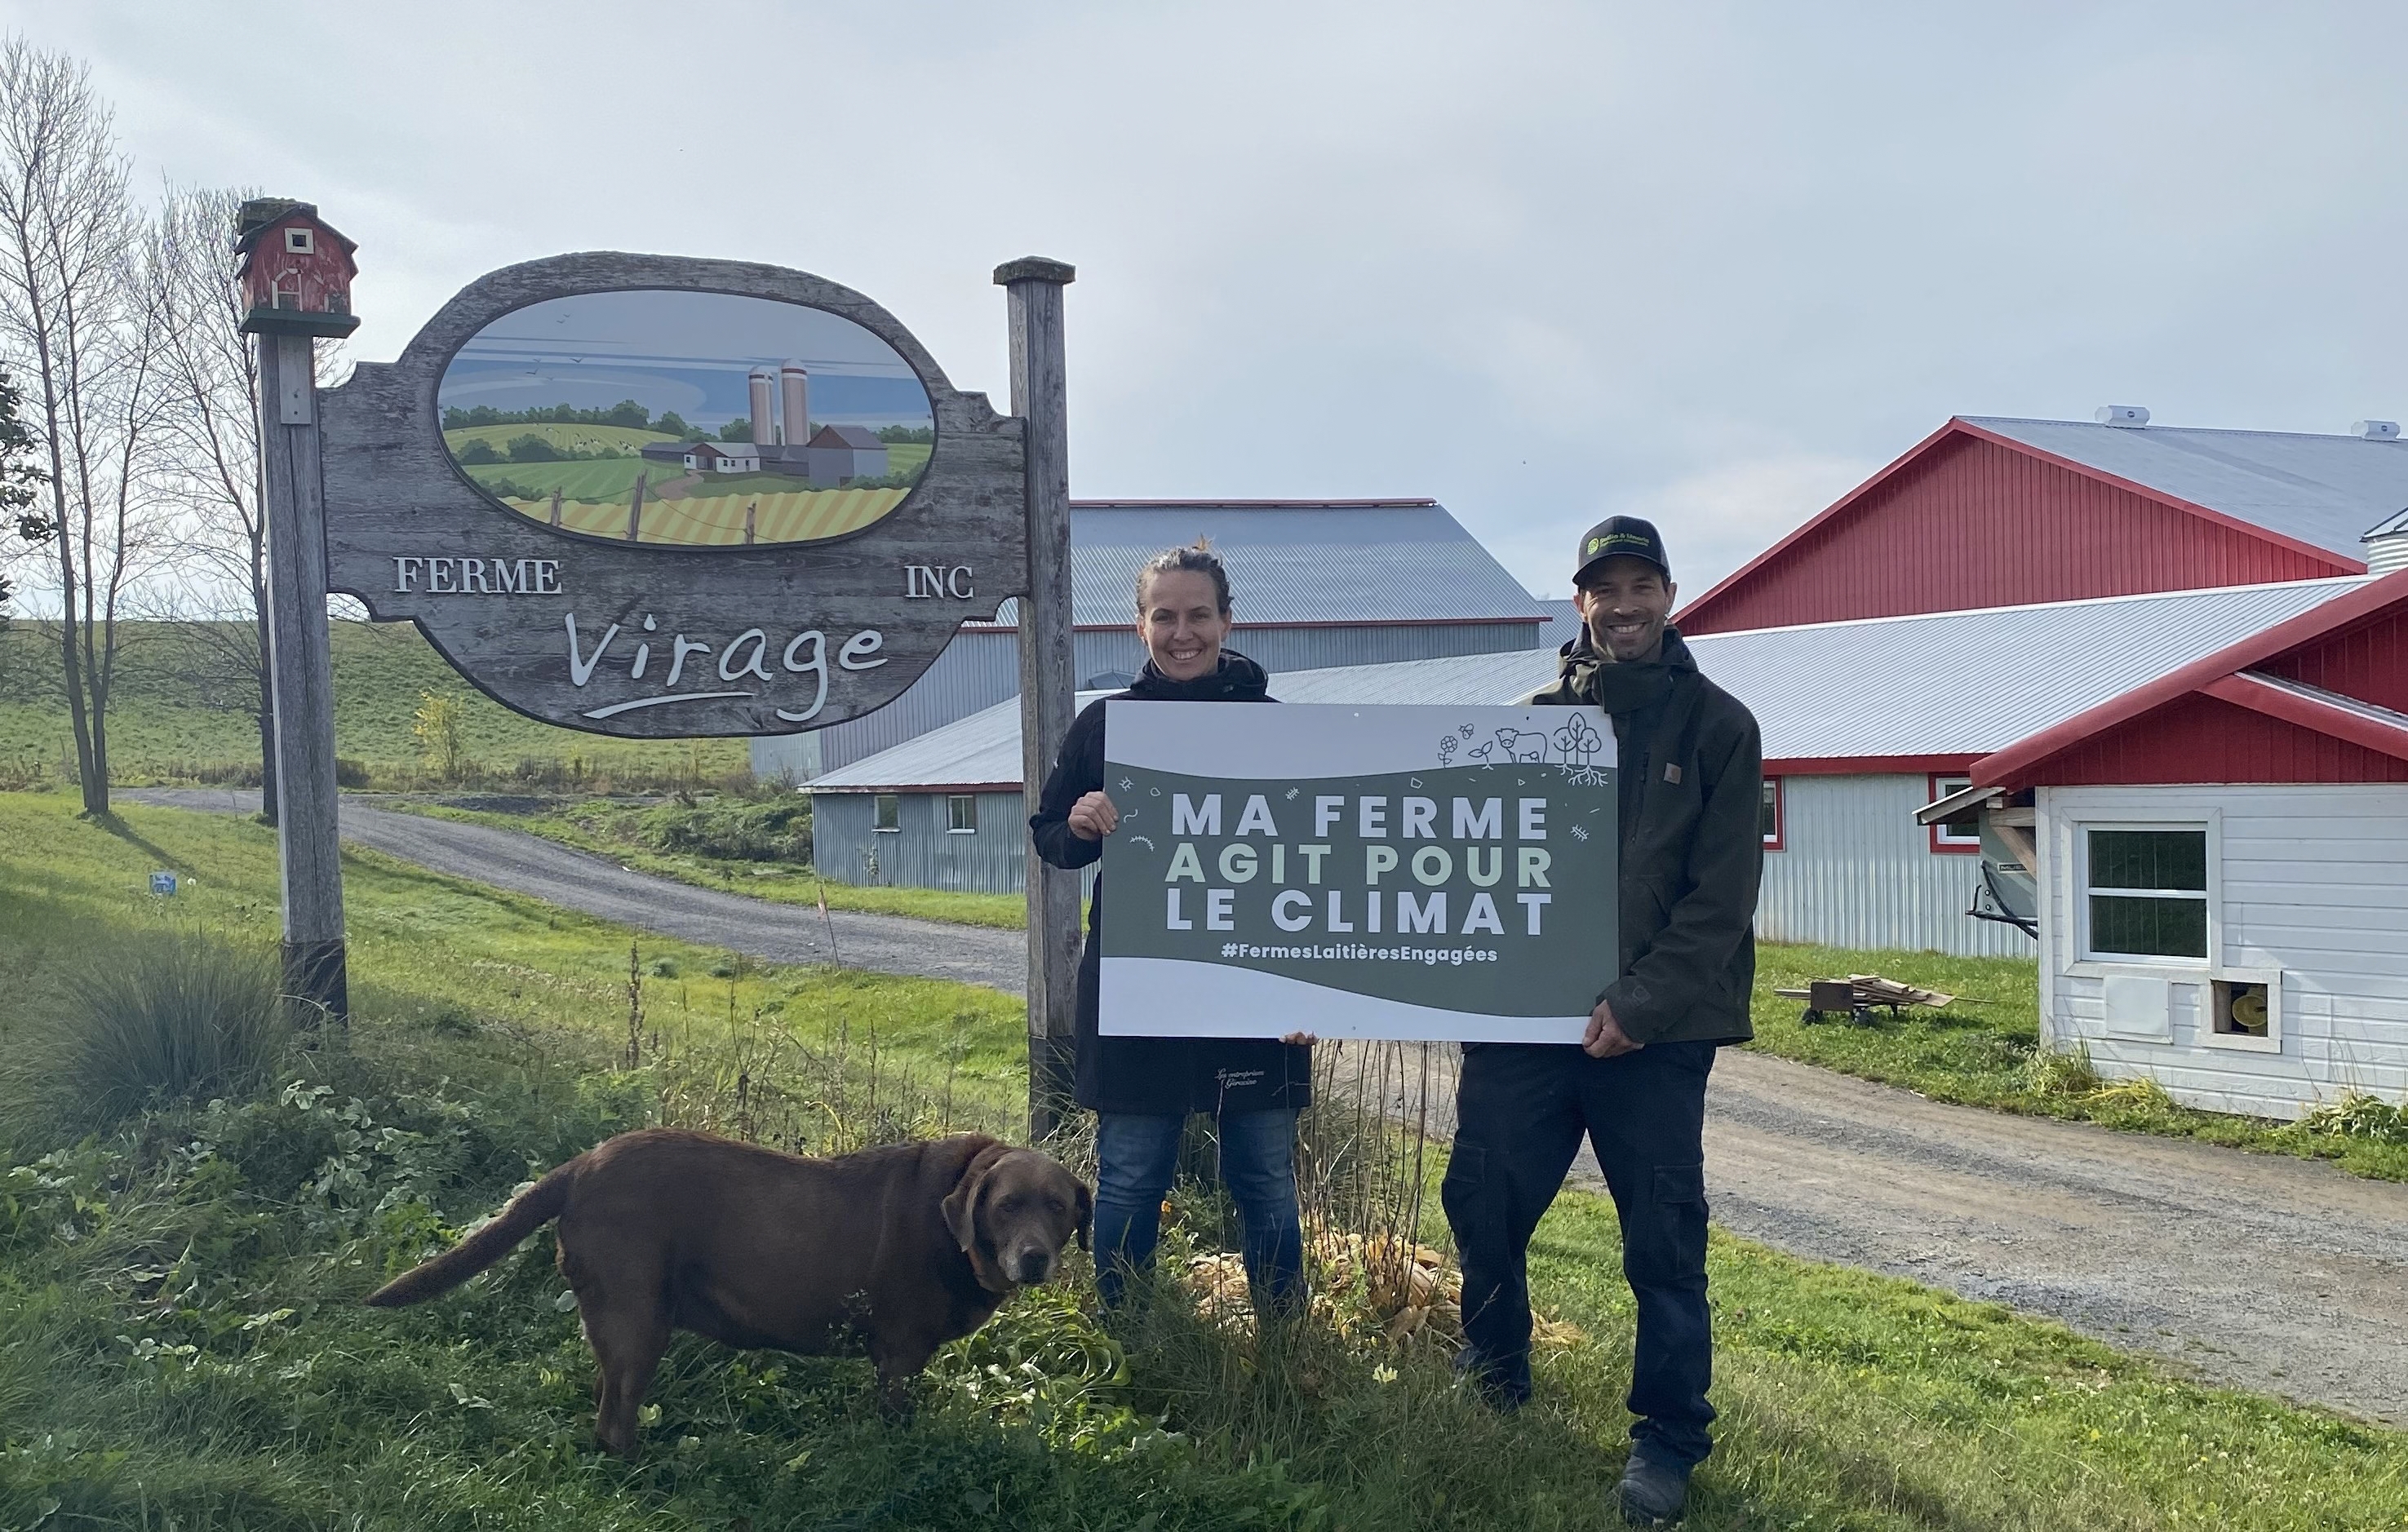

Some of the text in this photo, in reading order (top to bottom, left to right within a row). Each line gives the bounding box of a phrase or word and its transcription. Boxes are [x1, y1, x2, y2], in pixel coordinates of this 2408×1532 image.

[393, 556, 563, 595] FERME
[904, 565, 974, 600] INC
[564, 612, 889, 722] Virage
[1172, 793, 1548, 840] MA FERME
[1164, 843, 1552, 888] AGIT POUR
[1167, 888, 1553, 936] LE CLIMAT
[1221, 942, 1498, 966] #FermesLaitièresEngagées
